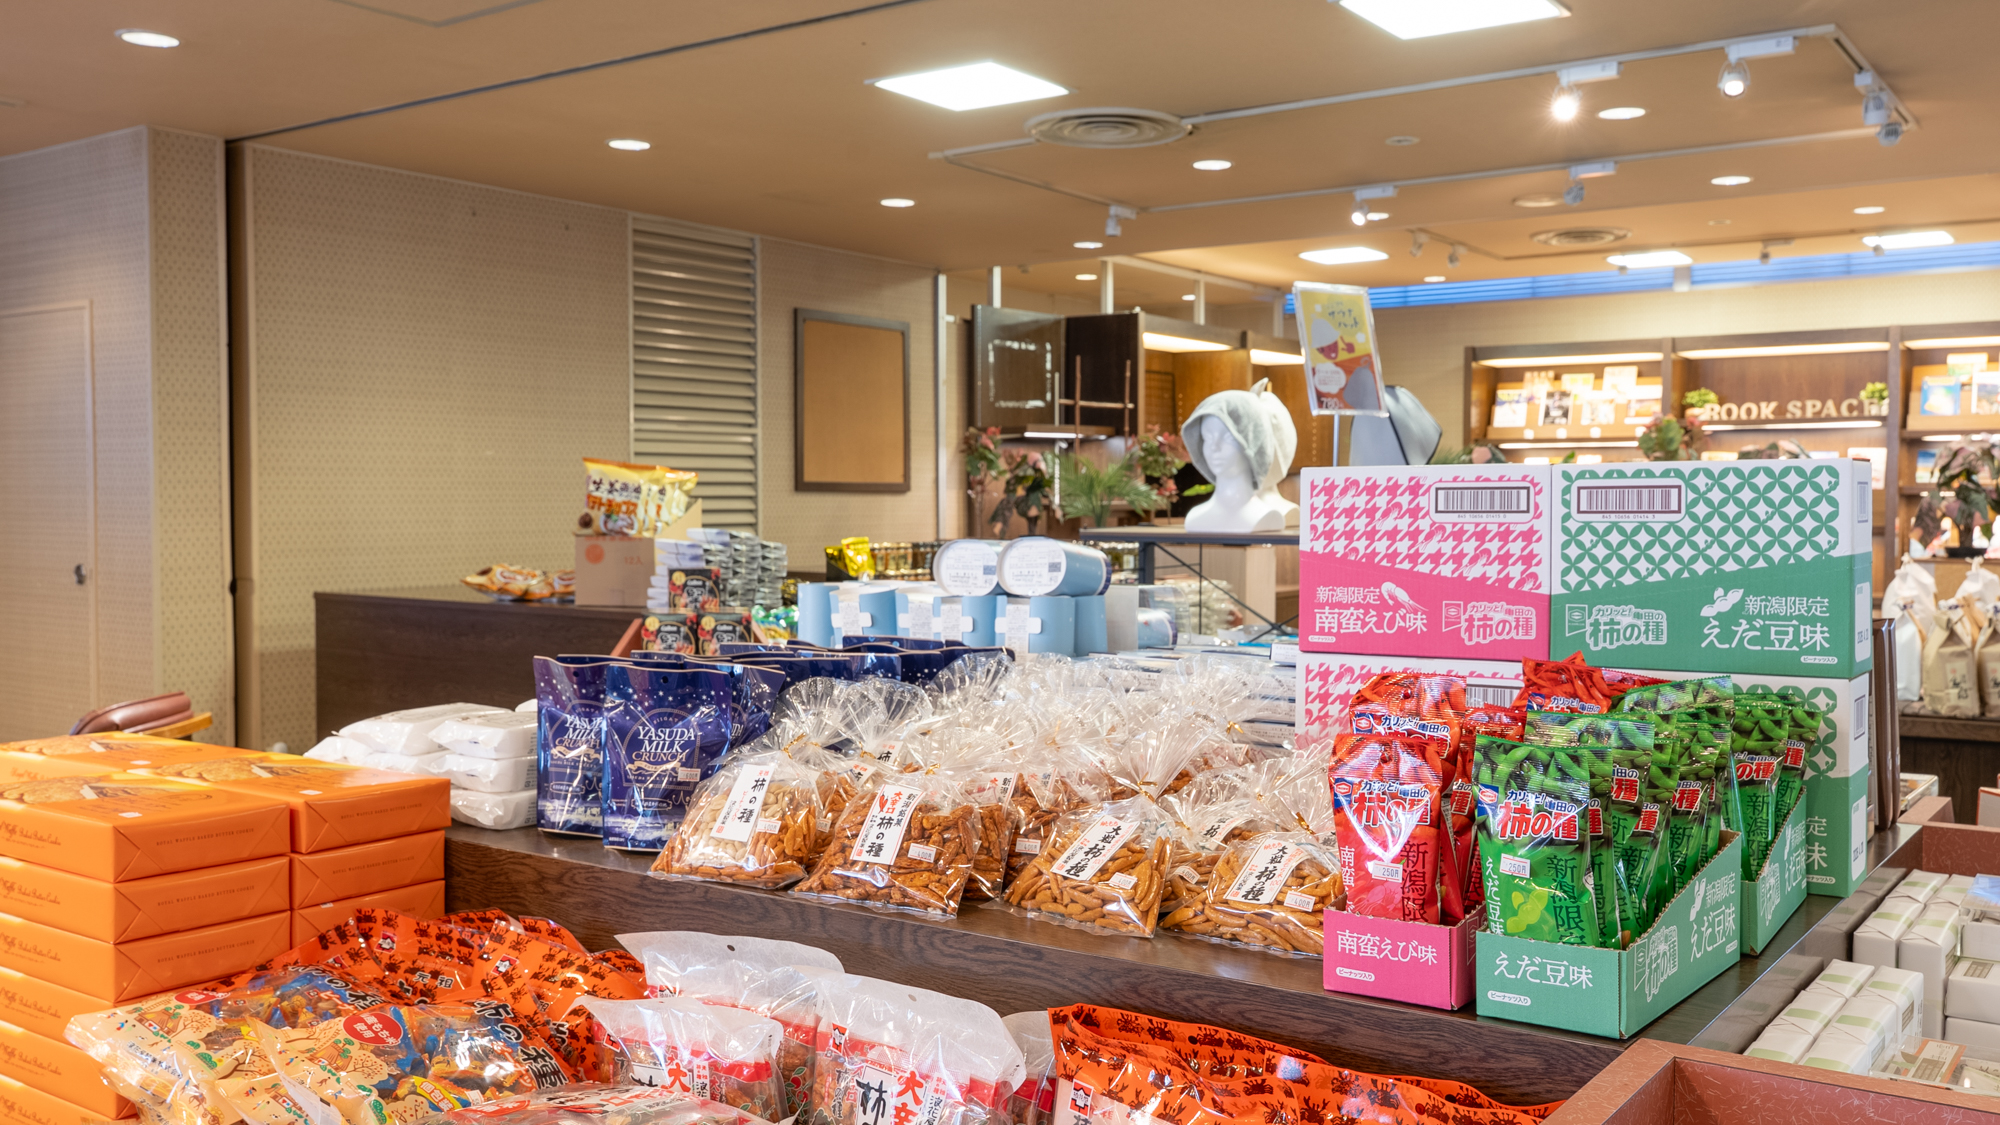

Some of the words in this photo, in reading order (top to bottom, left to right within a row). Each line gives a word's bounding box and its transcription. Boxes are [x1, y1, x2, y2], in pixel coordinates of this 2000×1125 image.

[1704, 401, 1778, 421] BOOK
[1786, 398, 1878, 418] SPACE
[1316, 586, 1380, 604] 新潟限定
[1744, 596, 1830, 617] 新潟限定
[1314, 606, 1428, 634] 南蛮えび味
[1464, 615, 1534, 643] 柿の種
[1589, 620, 1665, 648] 柿の種
[1701, 619, 1830, 651] えだ豆味
[564, 727, 597, 740] MILK
[637, 726, 695, 741] YASUDA
[631, 751, 687, 762] CRUNCH
[640, 740, 685, 753] MILK
[738, 777, 766, 823] 柿の種
[885, 791, 904, 815] 大辛口
[1353, 792, 1430, 828] 柿の種
[1498, 802, 1579, 839] 柿の種
[865, 815, 894, 857] 柿の種
[1508, 863, 1527, 874] 250円
[1294, 899, 1312, 909] 400円
[1691, 903, 1736, 962] えだ豆味
[1337, 929, 1438, 965] 南蛮えび味
[414, 971, 454, 989] 元祖
[1338, 968, 1373, 980] ピーナッツ入り
[1494, 951, 1594, 989] えだ豆味
[1490, 991, 1529, 1005] ピーナッツ入り
[661, 1062, 693, 1094] 大
